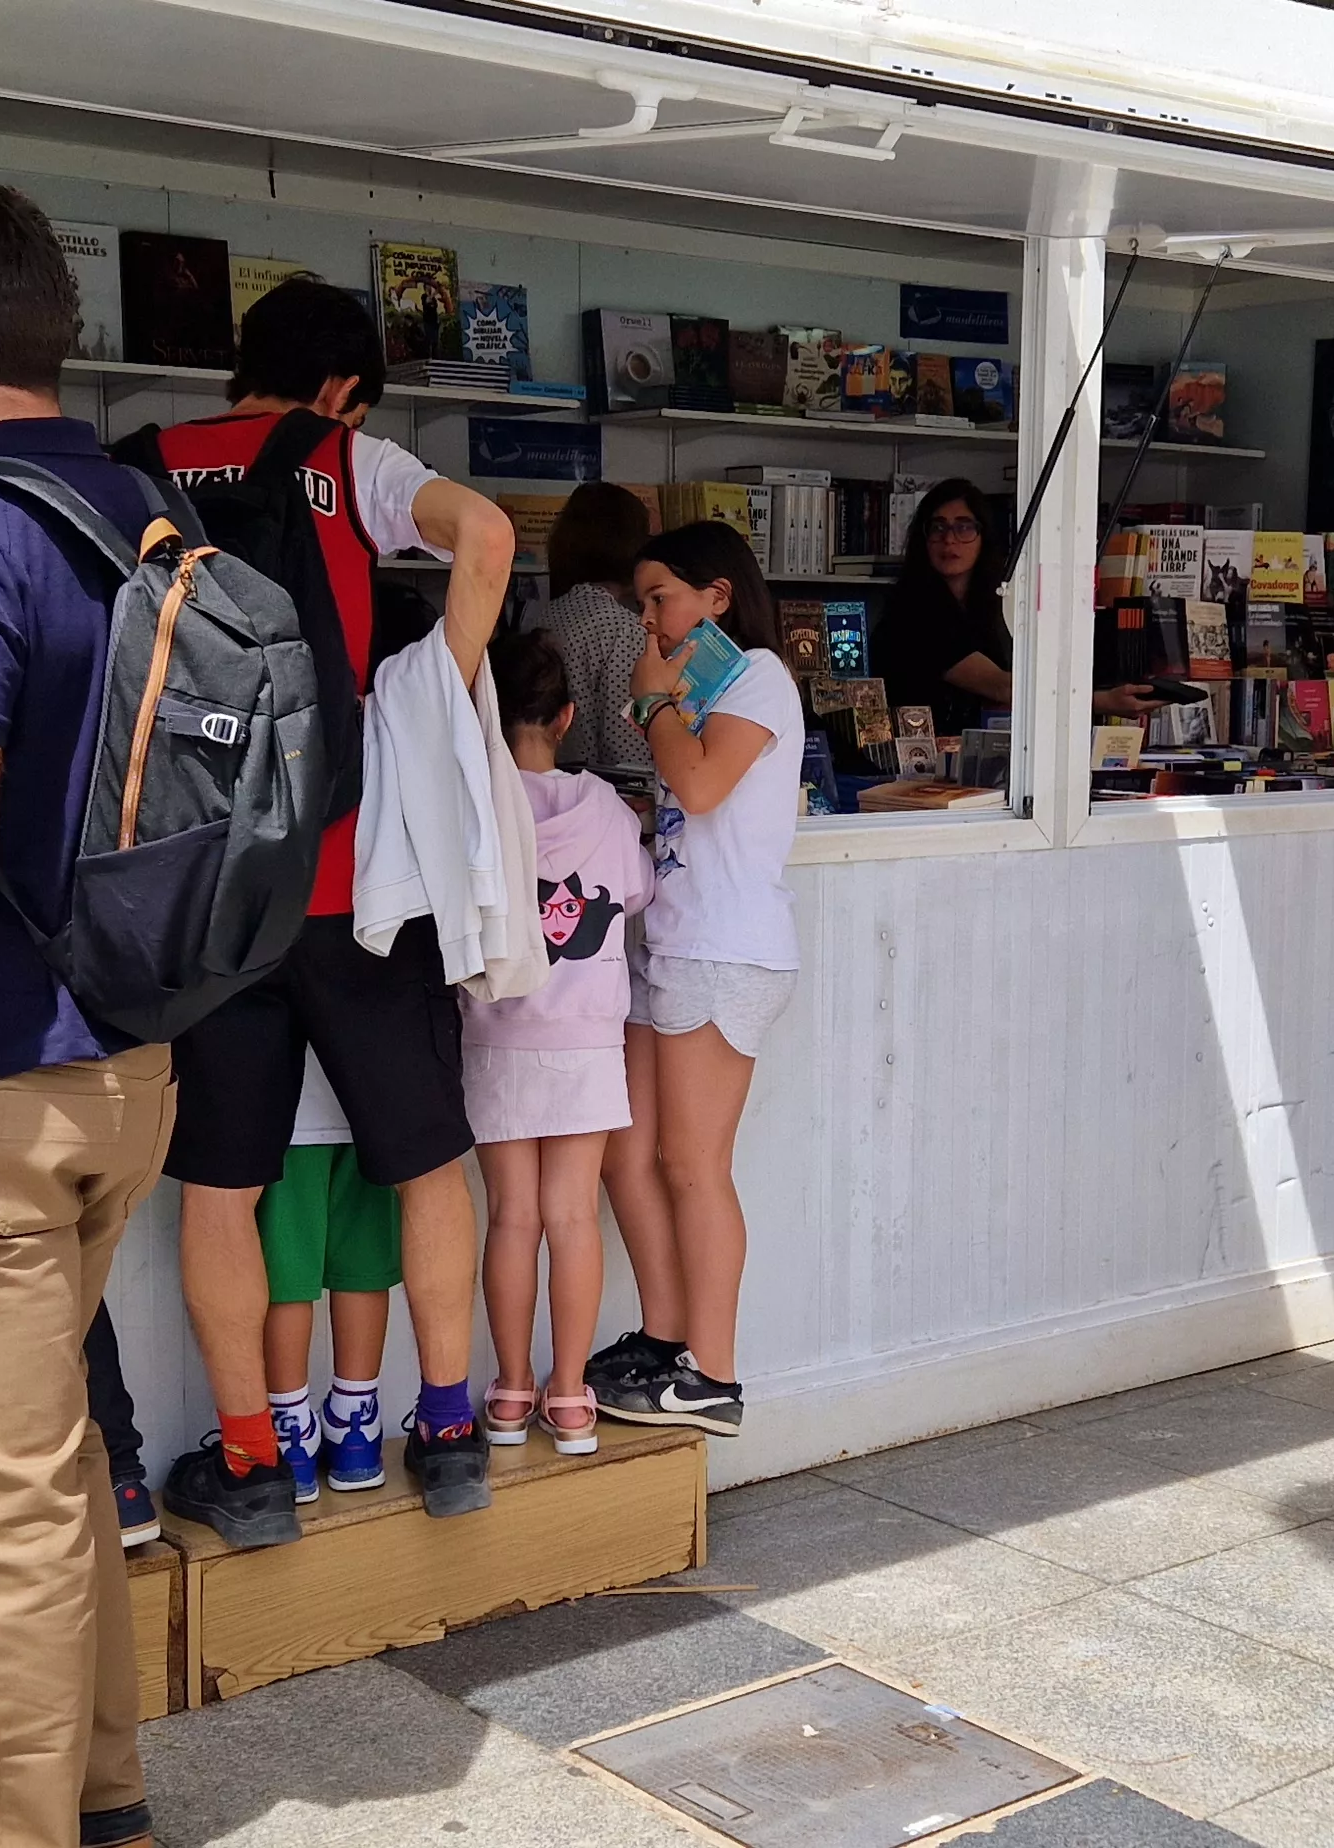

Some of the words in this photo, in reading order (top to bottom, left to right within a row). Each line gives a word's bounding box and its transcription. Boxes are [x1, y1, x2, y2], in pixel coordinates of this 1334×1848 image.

[239, 267, 250, 278] El
[235, 281, 248, 290] en
[619, 316, 652, 327] Orwell
[946, 312, 1004, 328] masdelibros
[526, 448, 599, 463] masdelibros
[1149, 538, 1159, 550] NI
[1162, 538, 1181, 550] UNA
[1162, 550, 1199, 562] GRANDE
[1148, 562, 1158, 573] NI
[1160, 562, 1187, 573] LIBRE
[1251, 579, 1300, 592] Covadonga
